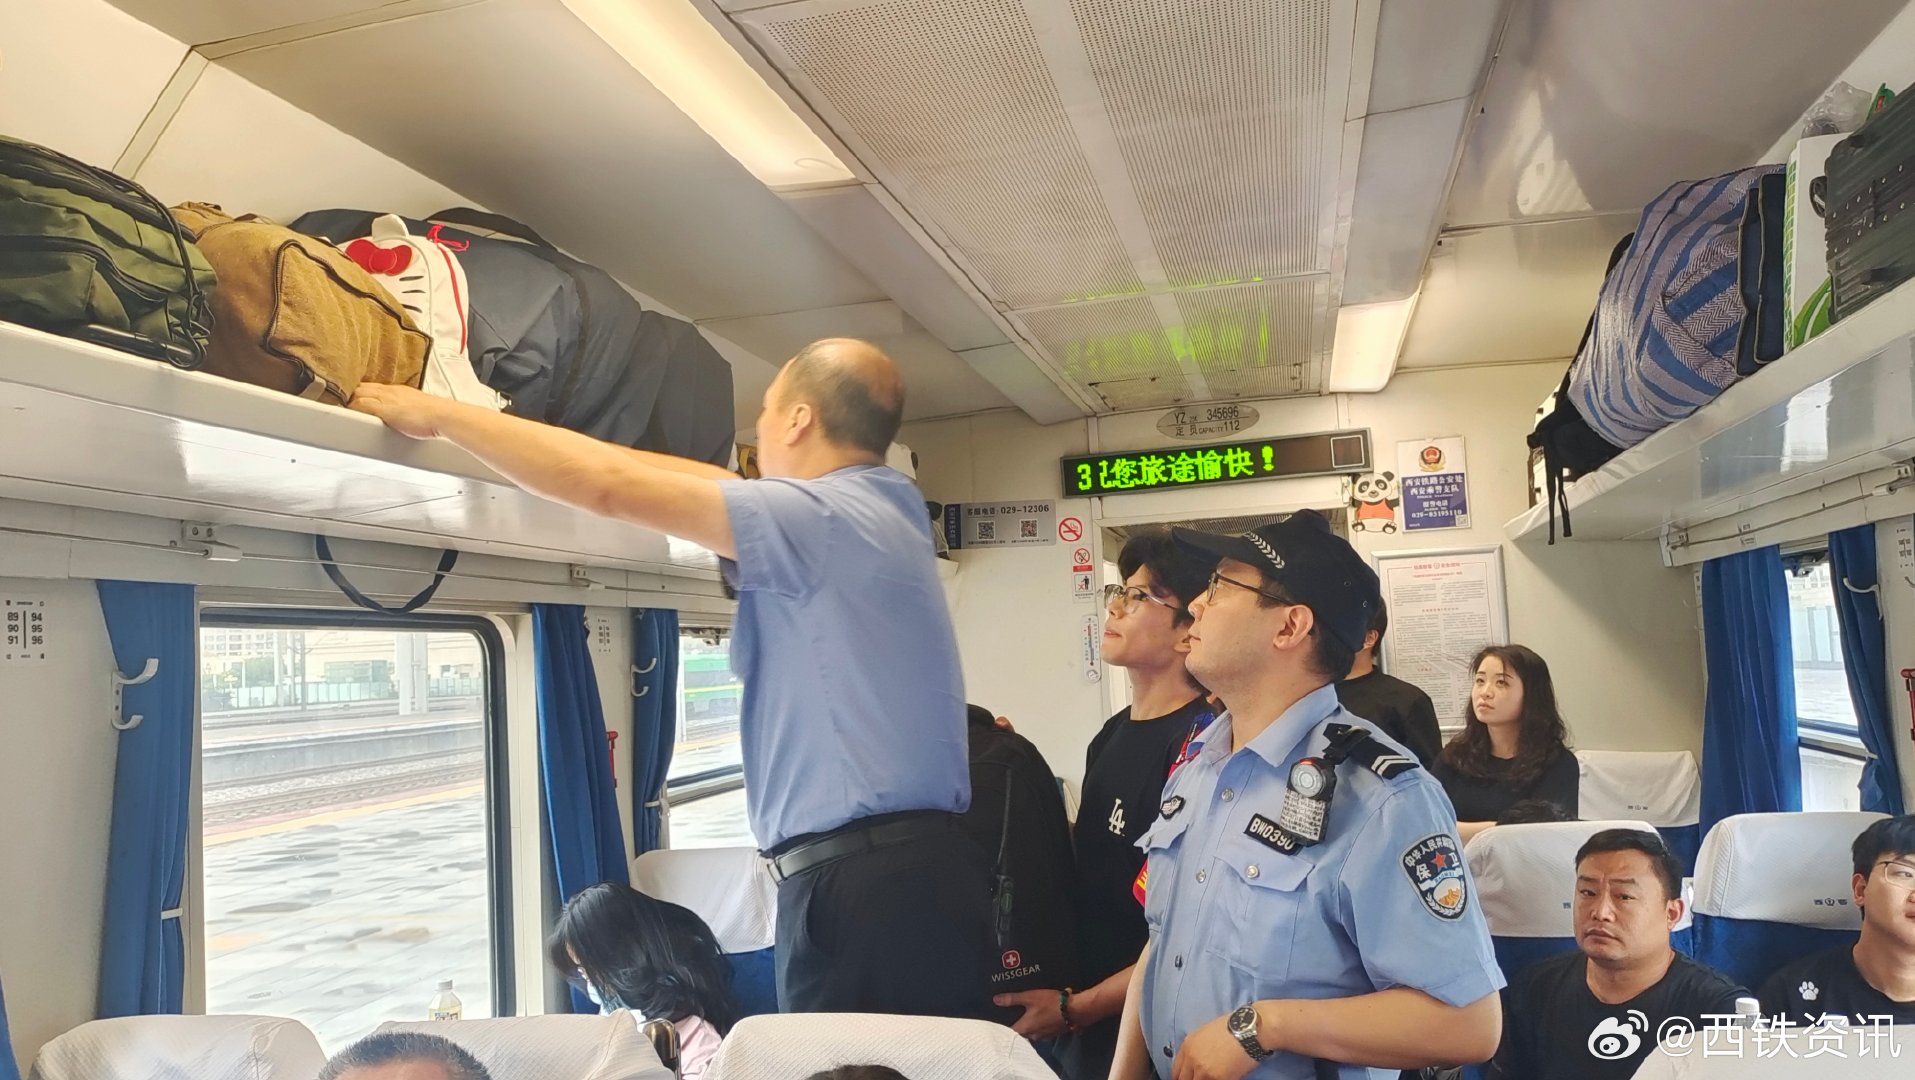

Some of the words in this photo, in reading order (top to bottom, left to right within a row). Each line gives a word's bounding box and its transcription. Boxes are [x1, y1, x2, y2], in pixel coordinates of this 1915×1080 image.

[1174, 412, 1187, 424] YZ
[1206, 405, 1240, 421] 345696
[1224, 419, 1240, 432] 112
[1405, 474, 1464, 487] 西安铁路公安处
[1410, 484, 1460, 496] 西安乘警支队
[7, 612, 19, 621] 89
[31, 612, 43, 621] 94
[7, 624, 19, 633] 90
[31, 624, 43, 633] 95
[7, 635, 19, 645] 91
[31, 635, 43, 645] 96
[1108, 798, 1126, 836] LA
[1404, 836, 1456, 868] 中华人民共和国
[991, 964, 1041, 983] WISSGEAR
